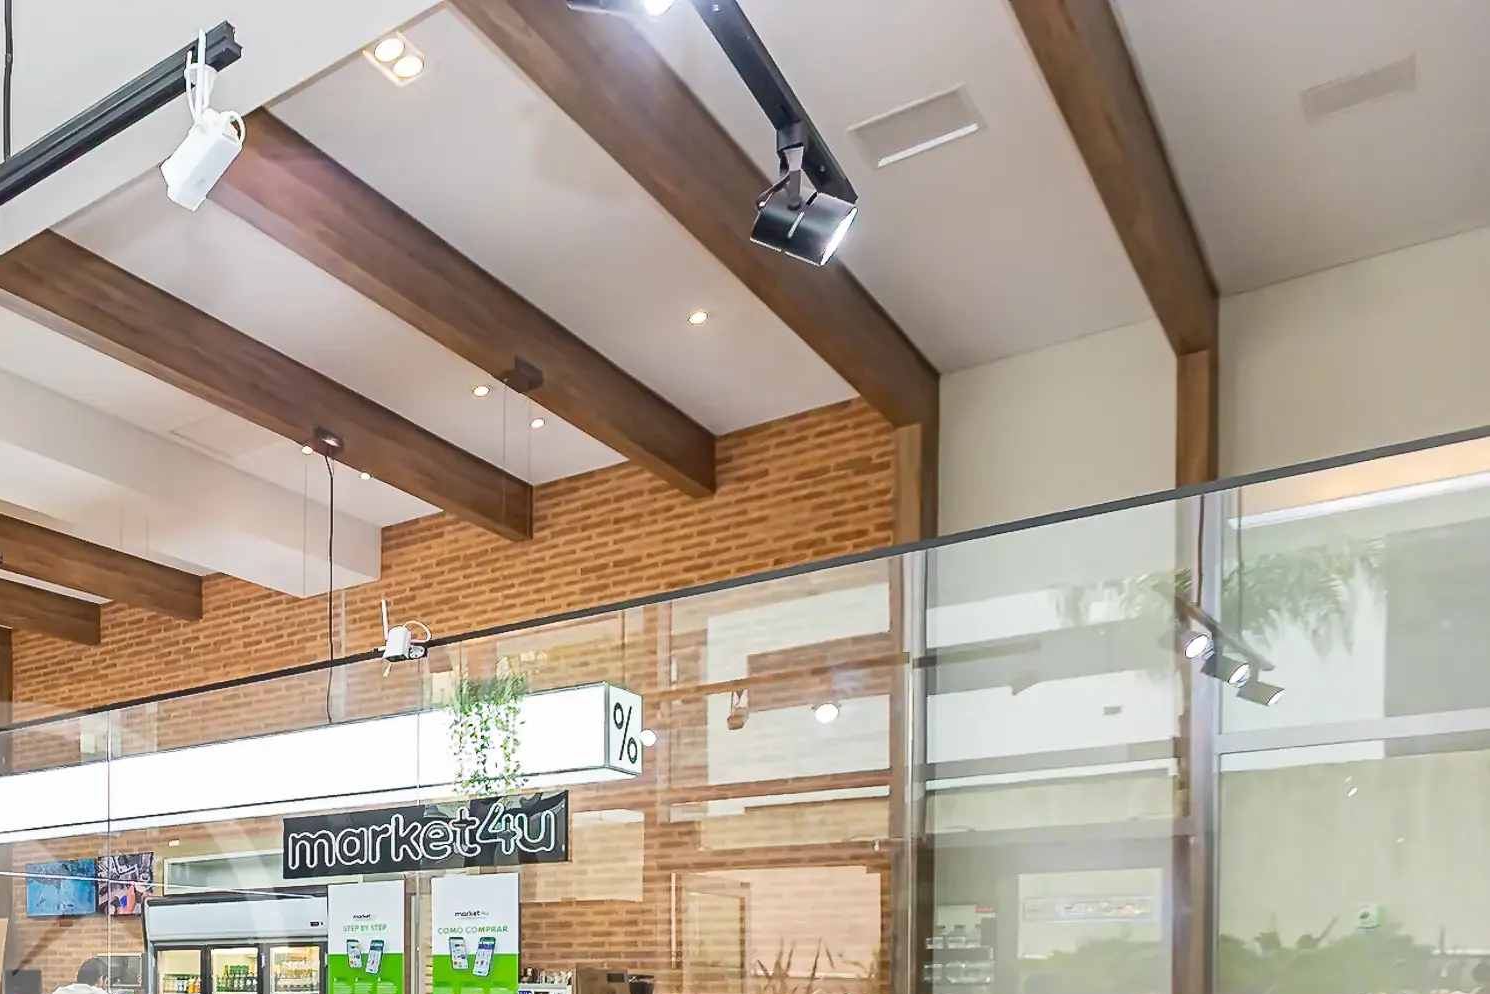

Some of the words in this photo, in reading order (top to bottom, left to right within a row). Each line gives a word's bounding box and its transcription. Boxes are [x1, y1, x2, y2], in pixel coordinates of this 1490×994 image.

[613, 701, 638, 764] %
[288, 801, 556, 870] market4u
[343, 924, 359, 932] STEP
[360, 924, 370, 932] BY
[437, 926, 464, 934] COMO
[465, 925, 508, 934] COMPRAR
